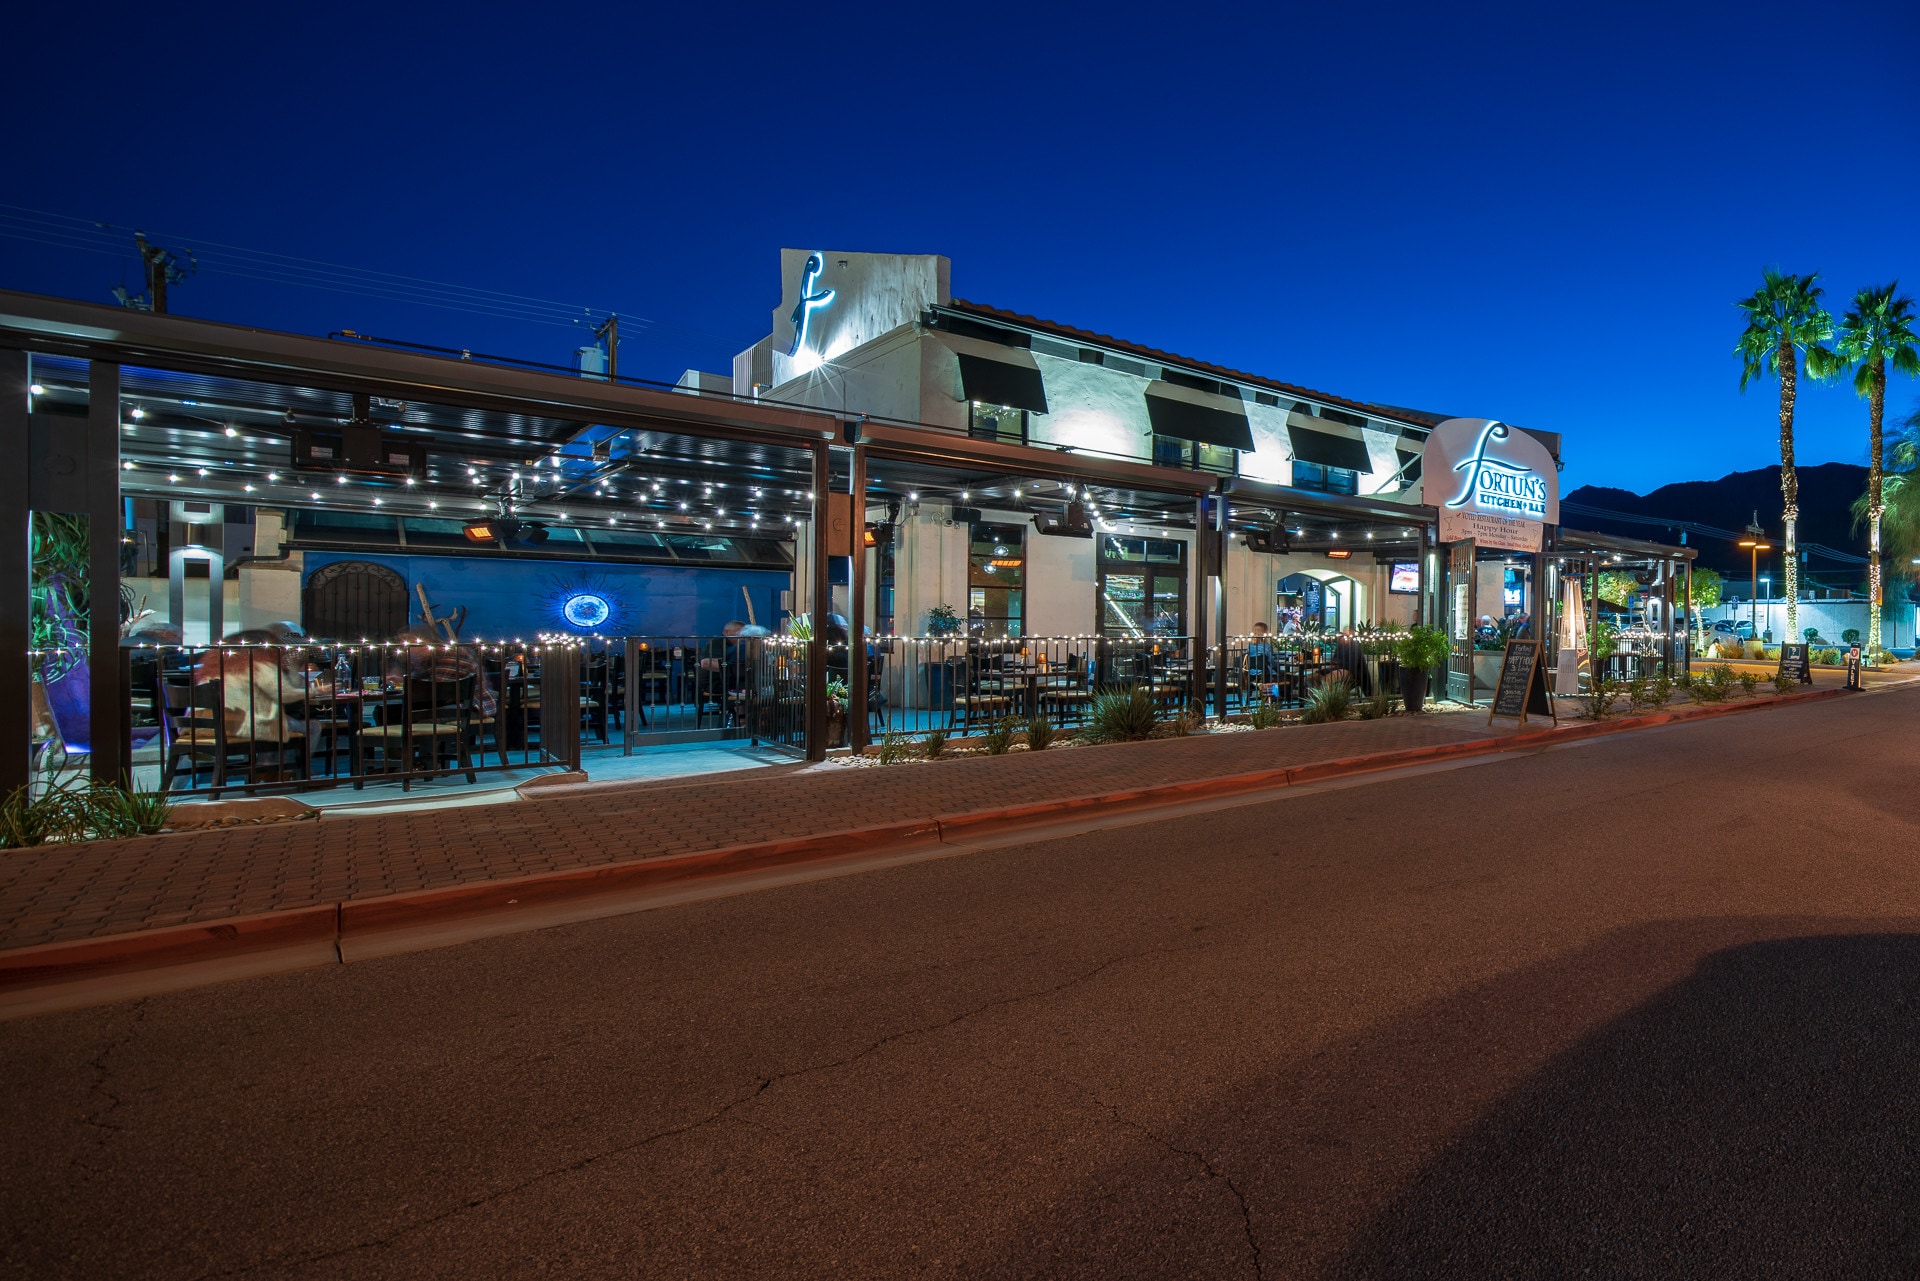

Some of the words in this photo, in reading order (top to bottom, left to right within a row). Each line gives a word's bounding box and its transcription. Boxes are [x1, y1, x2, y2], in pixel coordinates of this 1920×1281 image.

[1479, 494, 1522, 510] KITCHEN
[1528, 502, 1546, 514] BAR
[1476, 514, 1502, 525] RESTAURANT
[1472, 522, 1498, 533] Happy
[1499, 527, 1519, 535] Hour
[1488, 532, 1507, 540] Monday
[1508, 656, 1523, 665] HAPPY
